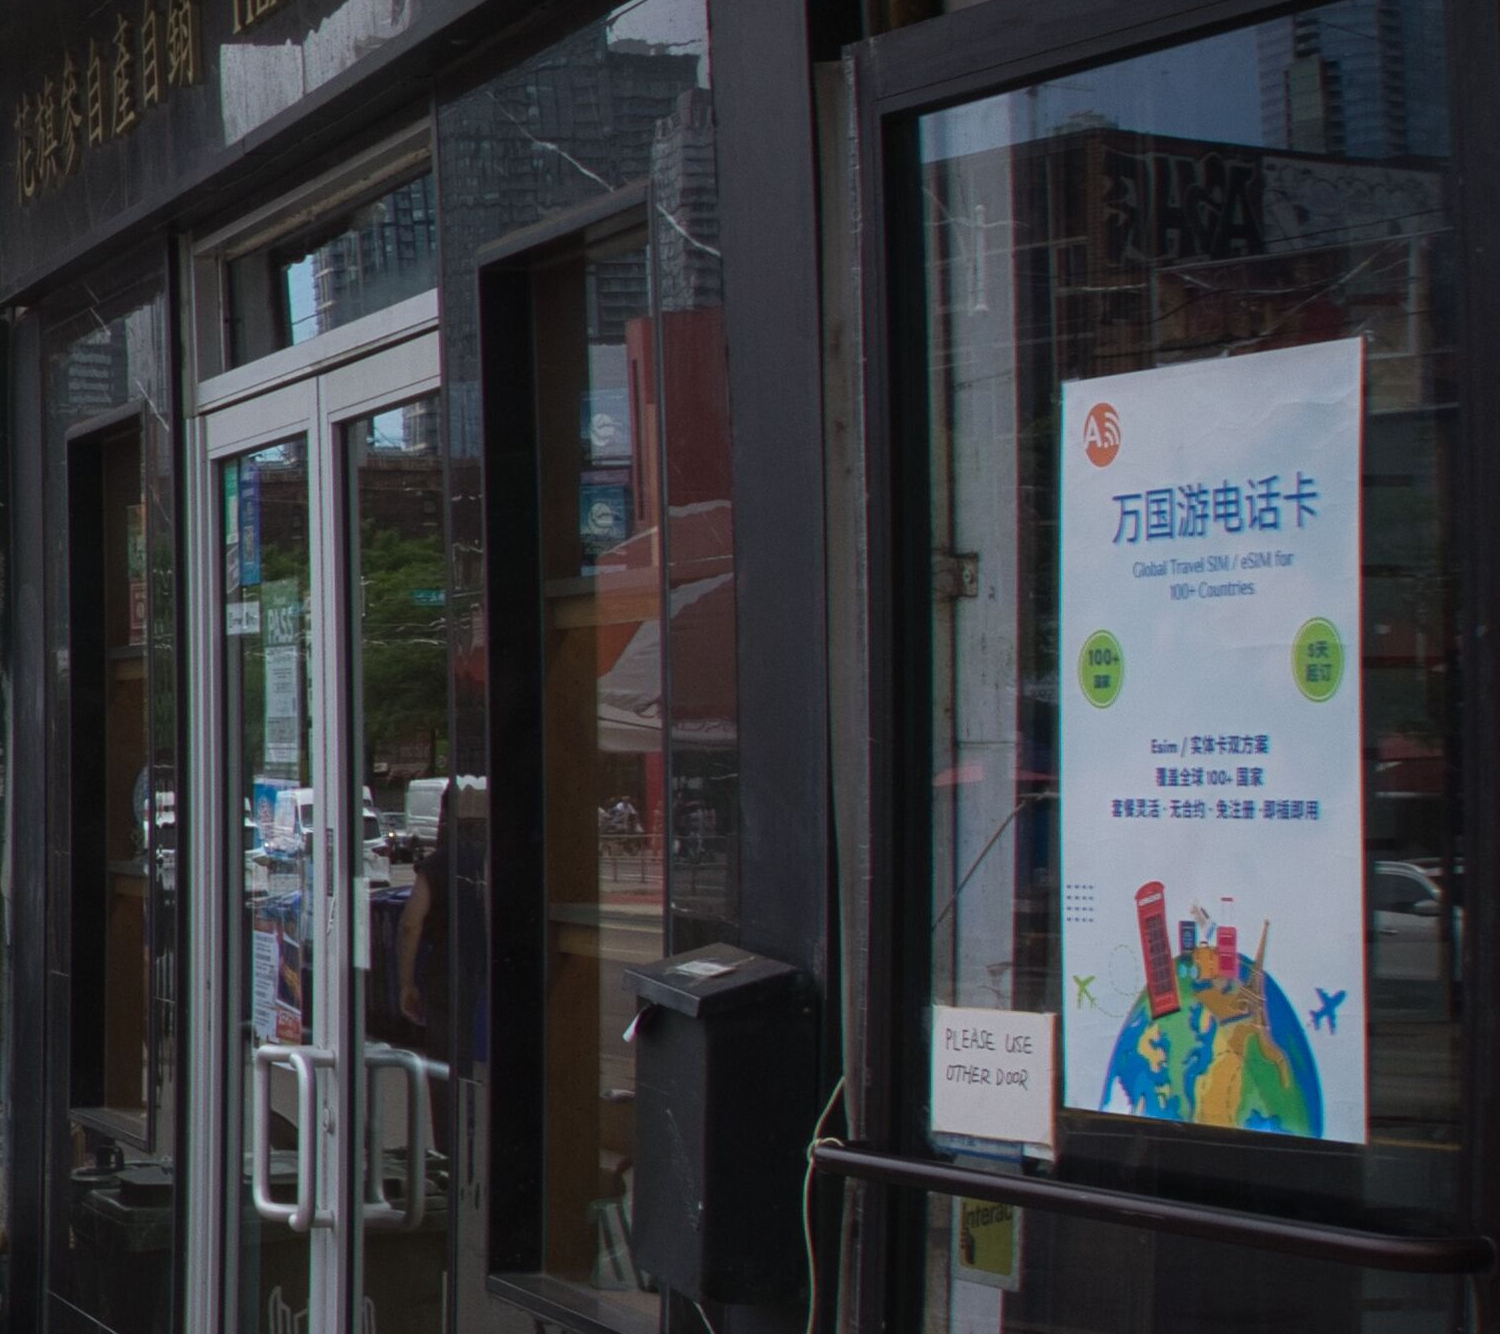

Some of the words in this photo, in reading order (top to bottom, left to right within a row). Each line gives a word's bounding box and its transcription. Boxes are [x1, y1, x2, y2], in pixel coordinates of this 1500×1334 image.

[1111, 472, 1319, 544] 万国游电话卡
[1132, 559, 1168, 579] Global
[1171, 556, 1205, 574] Travel
[1207, 554, 1229, 572] SIM
[1240, 552, 1271, 570] eSIM
[1274, 549, 1294, 567] for
[1170, 582, 1195, 601] 100+
[1198, 578, 1256, 599] Countries
[1151, 739, 1177, 754] Esim
[946, 1028, 996, 1052] PLEASE
[1005, 1033, 1033, 1055] USE
[946, 1064, 991, 1085] OTHER
[996, 1067, 1029, 1092] DOOR
